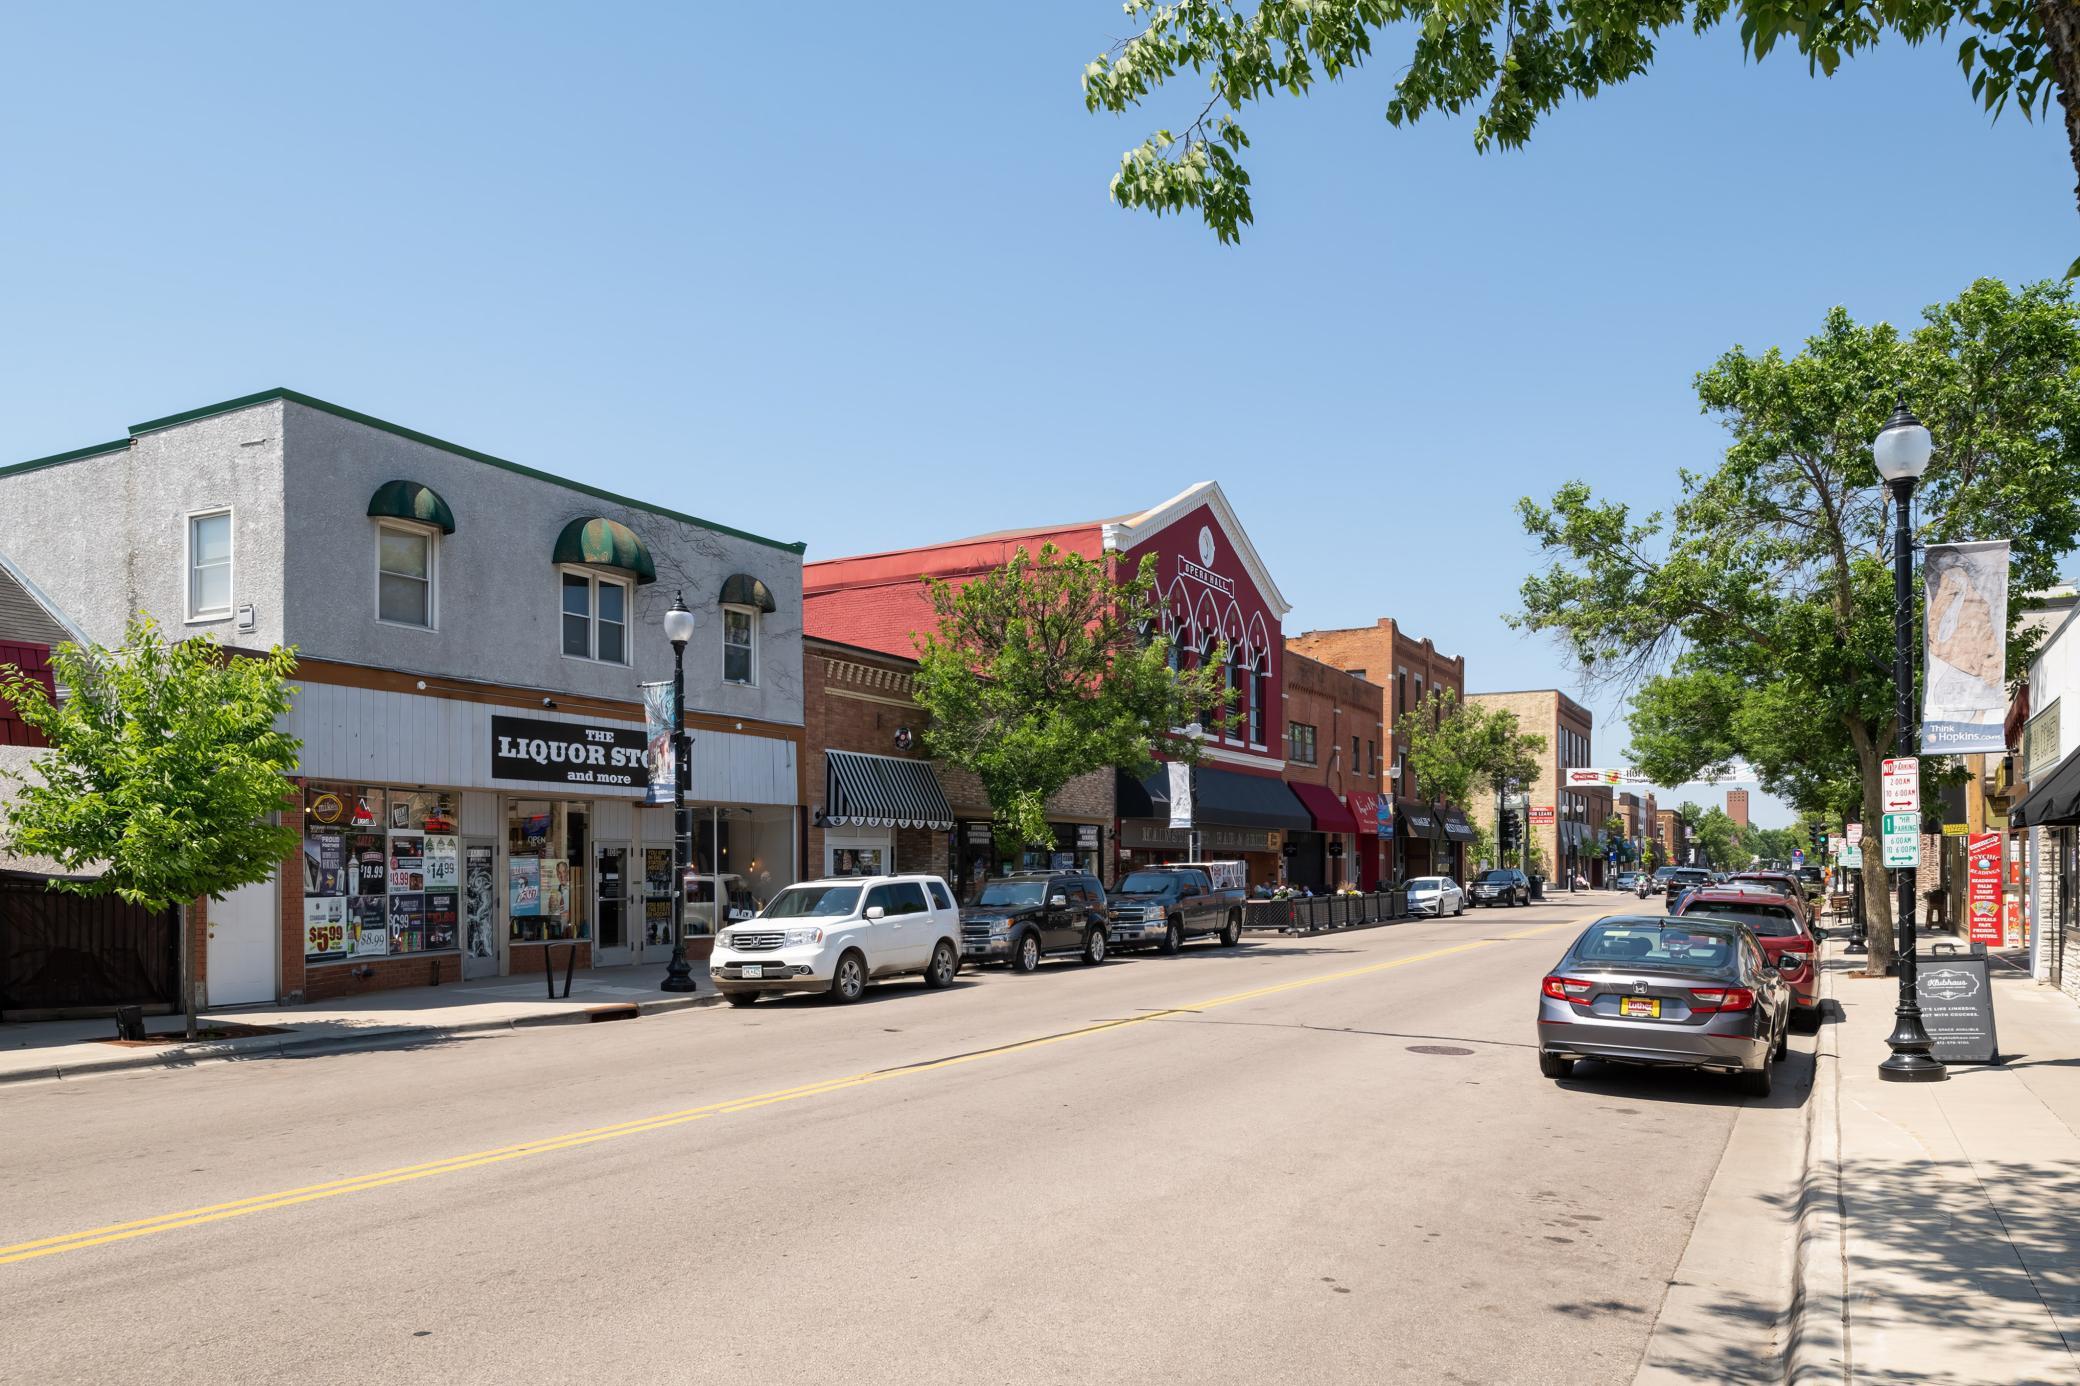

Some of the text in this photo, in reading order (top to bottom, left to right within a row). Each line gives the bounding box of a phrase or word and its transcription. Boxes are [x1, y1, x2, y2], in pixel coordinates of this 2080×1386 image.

[1185, 563, 1229, 591] OPERA HALL
[1930, 724, 1955, 733] Think
[585, 729, 615, 743] THE
[1939, 732, 2001, 743] Hopkins.com
[498, 736, 606, 765] LIQUOR
[1883, 763, 1916, 773] NO PARKING
[567, 770, 632, 784] and more
[527, 835, 546, 845] OPEN
[1969, 854, 2001, 862] PSYCHIC
[360, 864, 384, 879] $19.99
[389, 872, 409, 886] $13.99
[360, 932, 385, 947] $8.99
